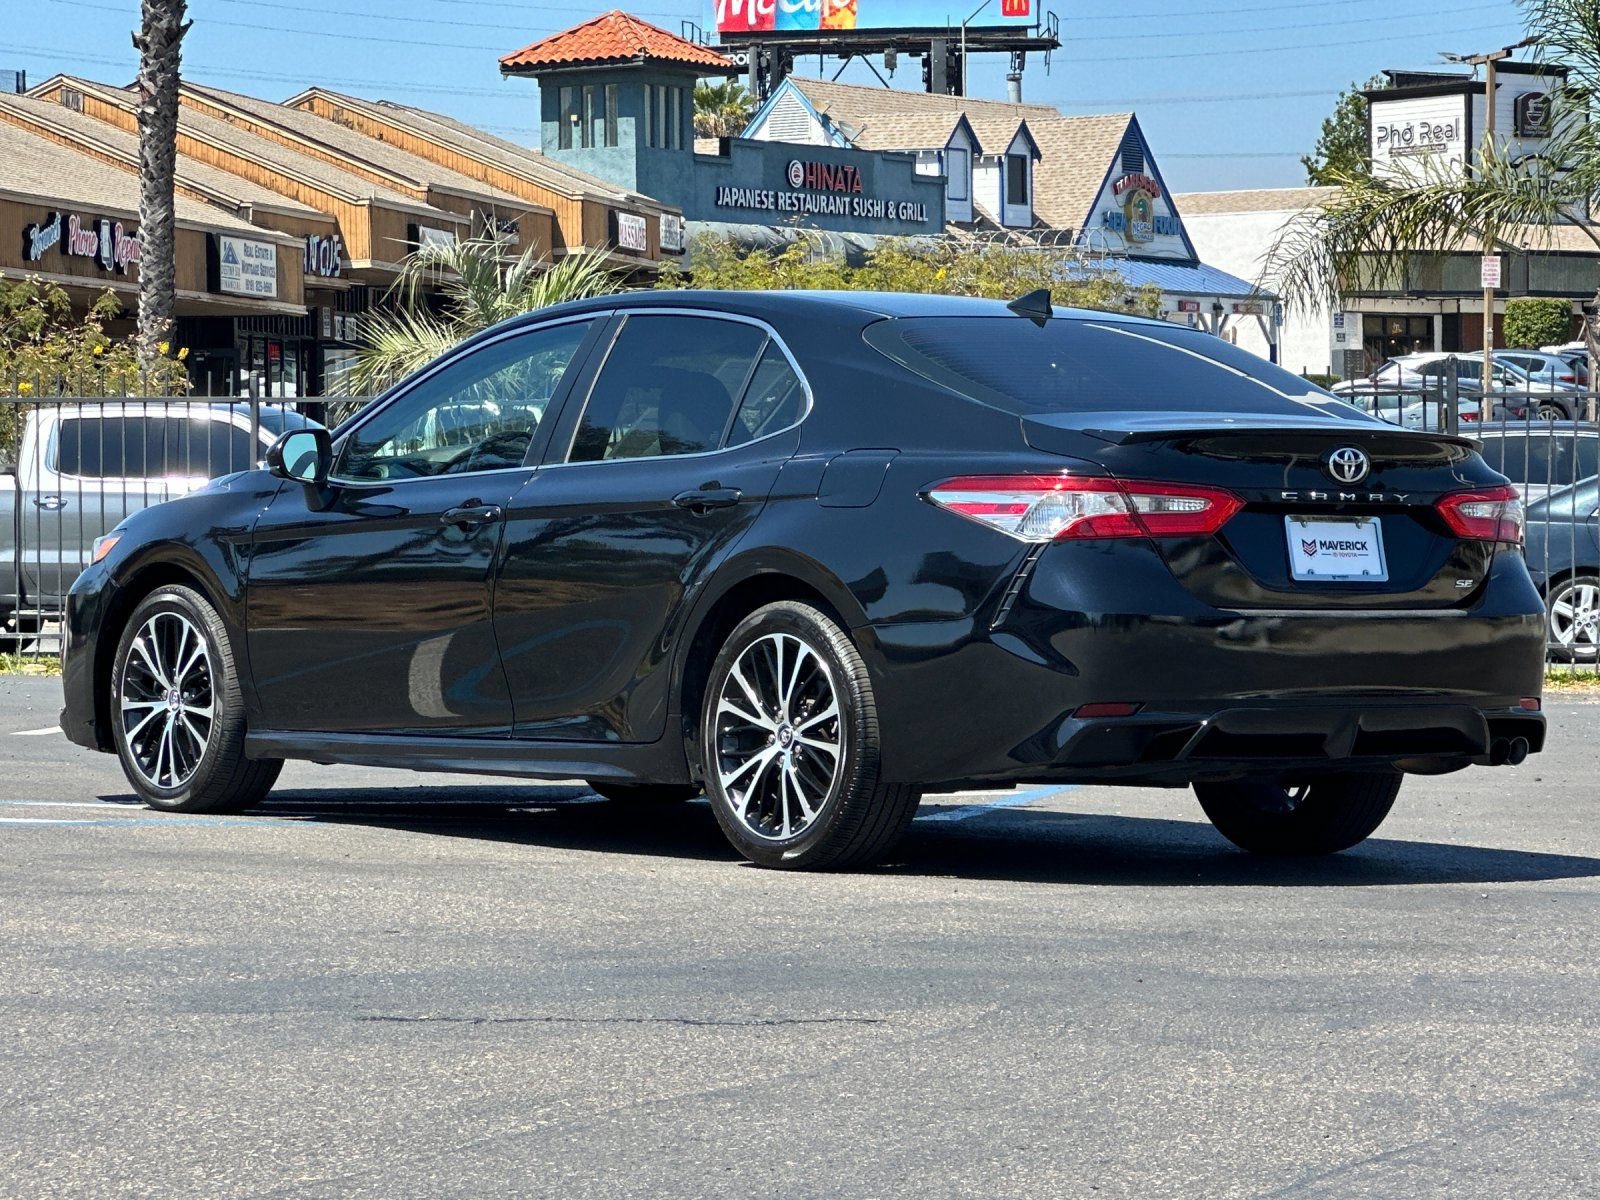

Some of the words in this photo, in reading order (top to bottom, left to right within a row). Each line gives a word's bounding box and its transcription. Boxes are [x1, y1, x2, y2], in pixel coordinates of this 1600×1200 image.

[1419, 118, 1460, 143] Real
[804, 161, 864, 193] HINATA
[717, 187, 775, 210] JAPANESE
[778, 191, 850, 216] RESTAURANT
[853, 198, 885, 218] SUSHI
[888, 200, 898, 217] &
[898, 204, 929, 222] GRILL
[68, 214, 99, 257] Phone
[1281, 491, 1411, 503] CAMRY
[1319, 541, 1370, 552] MAVERICK
[1455, 579, 1475, 589] SE
